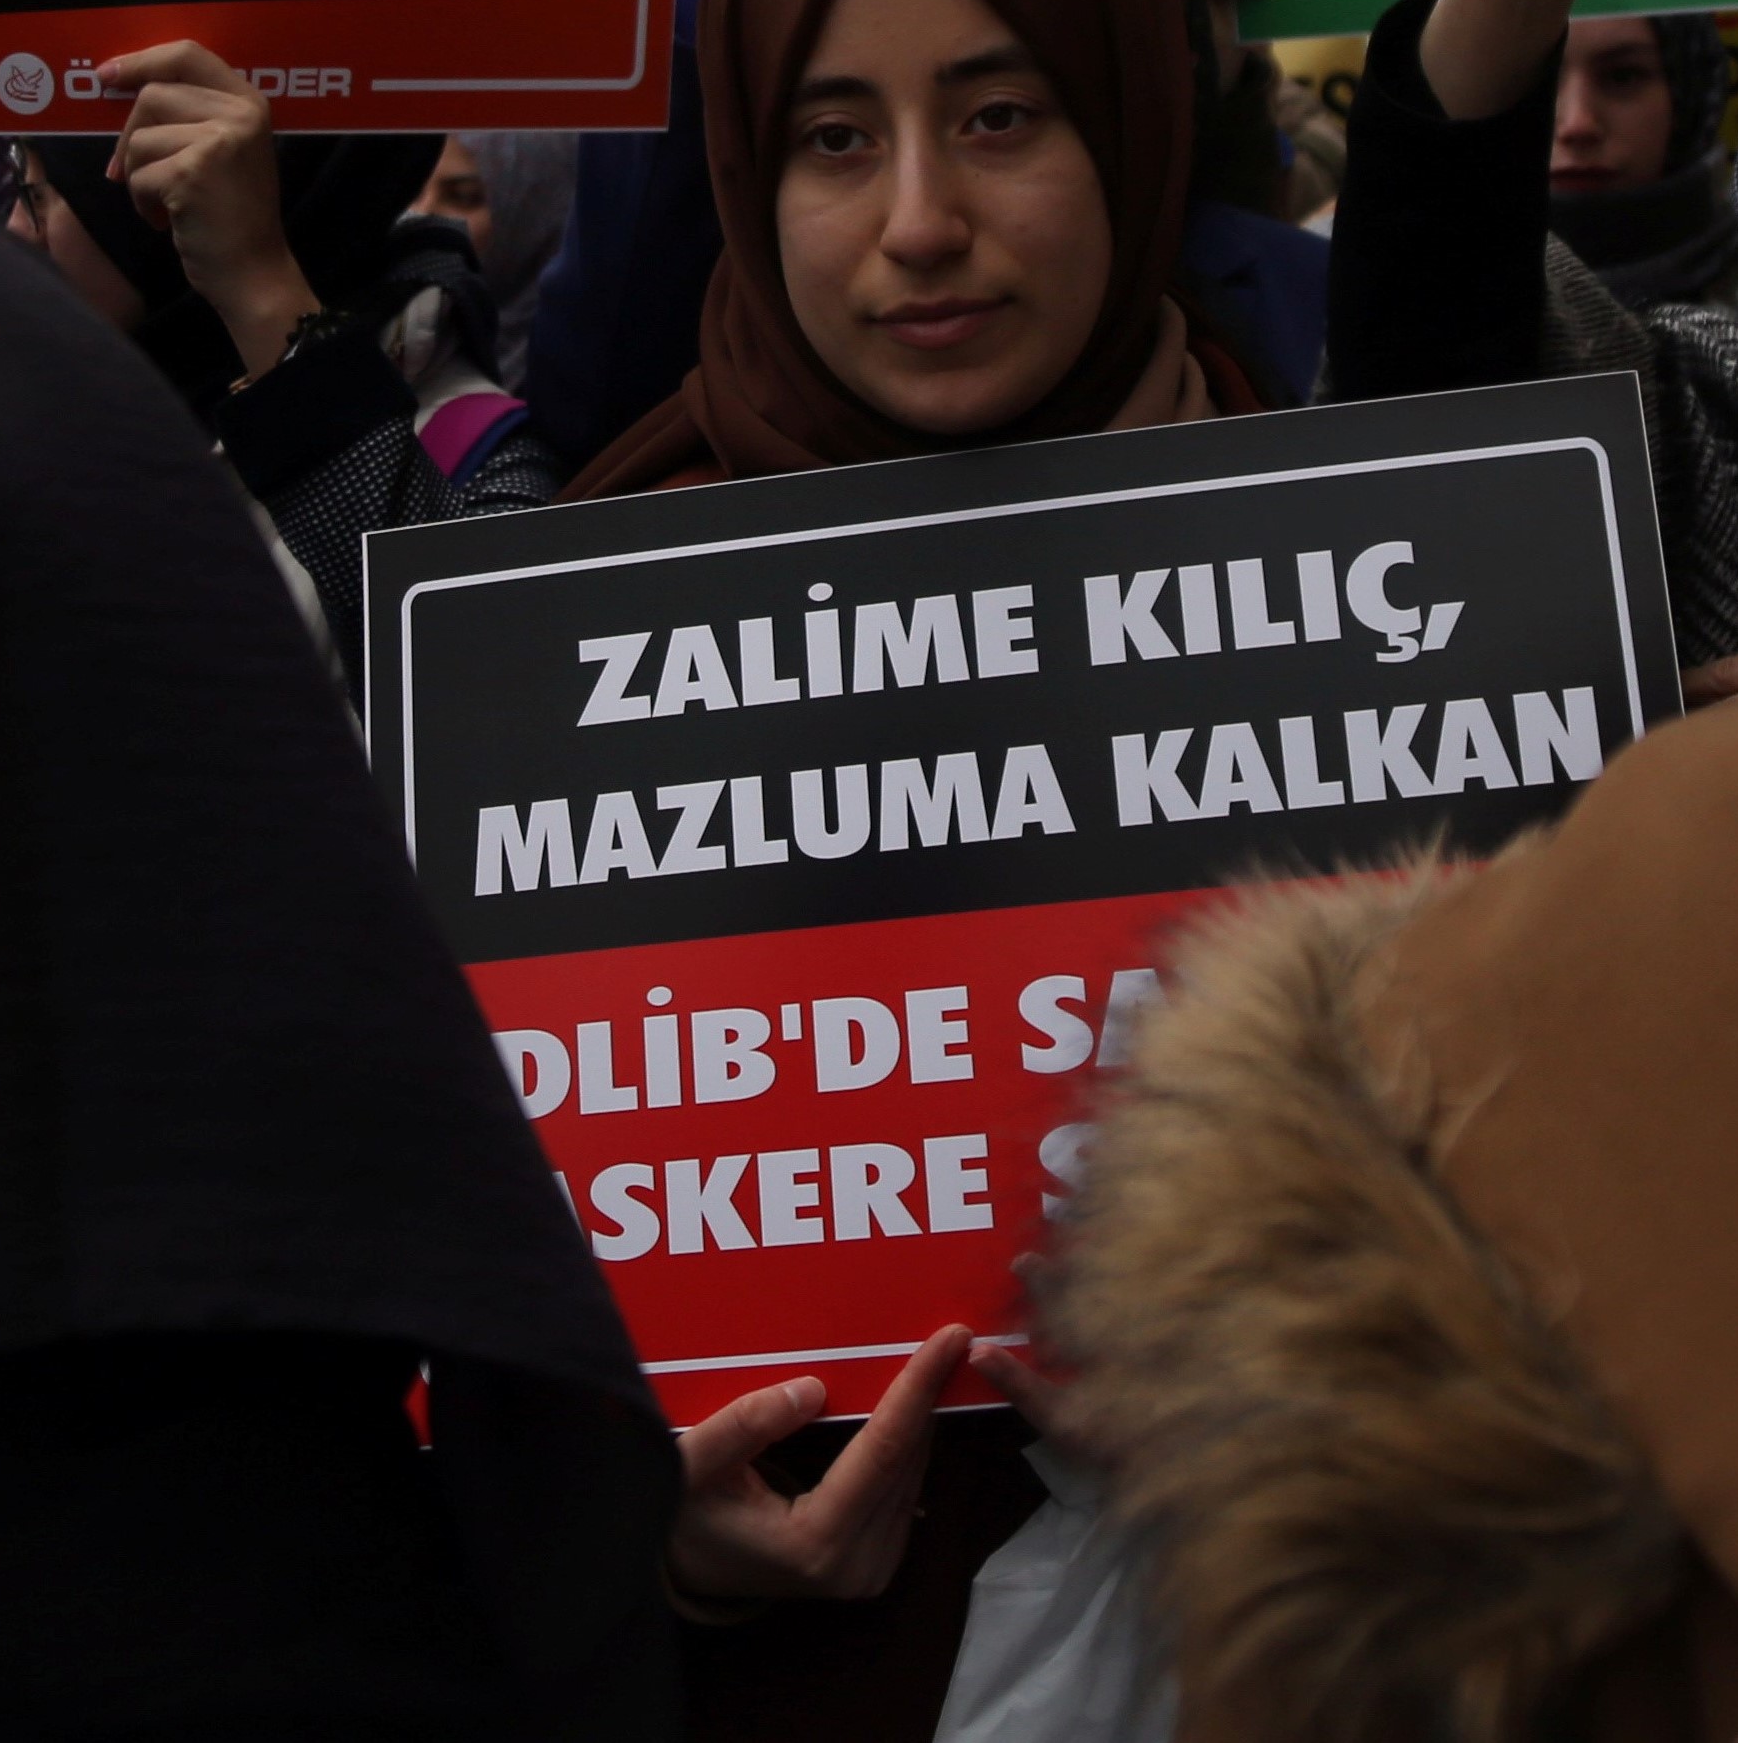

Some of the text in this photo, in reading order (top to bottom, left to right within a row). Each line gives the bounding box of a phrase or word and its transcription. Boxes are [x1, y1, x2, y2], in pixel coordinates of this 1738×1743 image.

[577, 541, 1464, 726] ZALİME KILIÇ,
[475, 687, 1602, 896] MAZLUMA KALKAN
[493, 986, 973, 1118] DLİB'DE
[553, 1134, 994, 1261] SKERE
